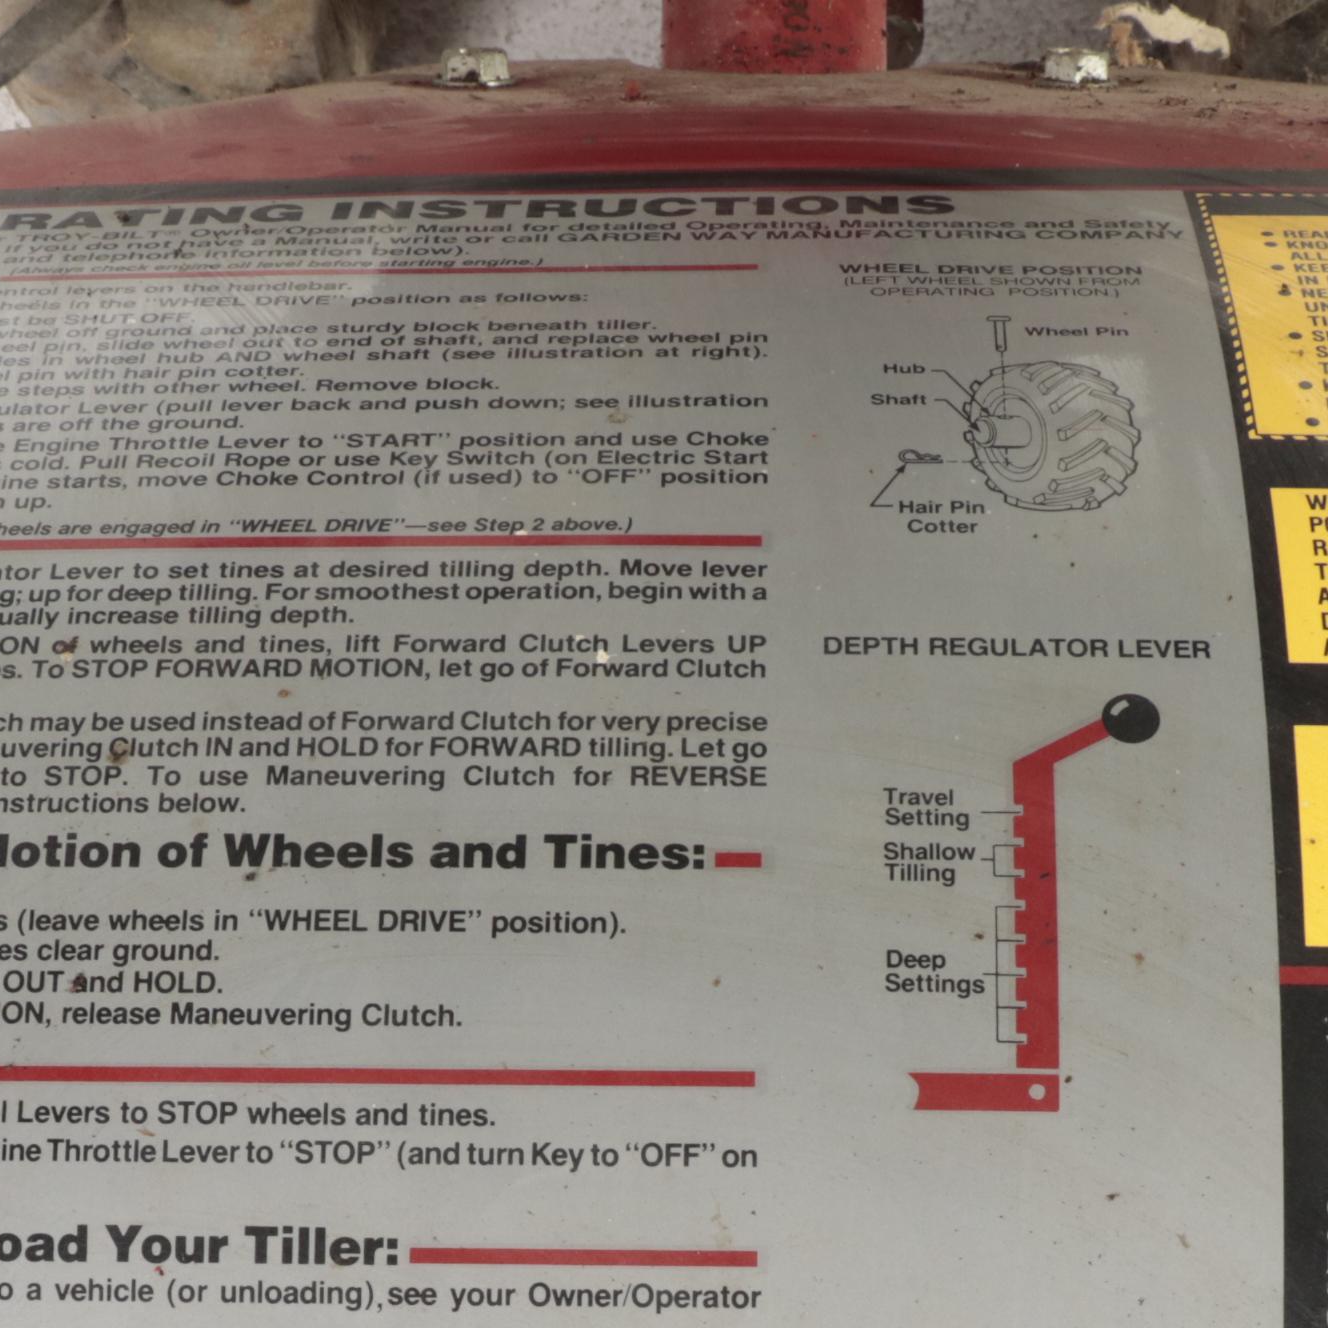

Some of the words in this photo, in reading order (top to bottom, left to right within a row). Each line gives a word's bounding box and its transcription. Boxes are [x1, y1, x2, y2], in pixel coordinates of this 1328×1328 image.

[332, 196, 954, 222] INSTRUCTIONS
[840, 264, 928, 273] WHEEL
[938, 265, 1013, 274] DRIVE
[1022, 266, 1142, 275] POSITION
[844, 276, 899, 286] (LEFT
[908, 276, 982, 285] WHEEL
[990, 277, 1070, 286] SHOWN
[1078, 278, 1140, 286] FROM
[870, 287, 994, 296] OPERATING
[1025, 327, 1088, 336] Wheel
[1096, 327, 1128, 336] Pin
[884, 364, 925, 374] Hub
[871, 394, 926, 405] Shaft
[899, 500, 942, 514] Hair
[950, 501, 984, 514] Pin
[908, 519, 978, 533] Cotter
[68, 608, 178, 624] increase
[189, 606, 261, 628] tilling
[270, 606, 354, 628] depth.
[824, 637, 918, 655] DEPTH
[930, 637, 1108, 657] REGULATOR
[1118, 640, 1210, 658] LEVER
[883, 788, 953, 806] Travel
[886, 808, 969, 831] Setting
[158, 833, 208, 868] of
[224, 834, 413, 868] Wheels
[430, 834, 526, 869] and
[544, 834, 704, 870] Tines:
[884, 842, 975, 860] Shallow
[884, 863, 955, 887] Tilling
[887, 950, 946, 974] Deep
[885, 974, 985, 998] Settings
[106, 1225, 228, 1264] Your
[245, 1226, 398, 1266] Tiller:
